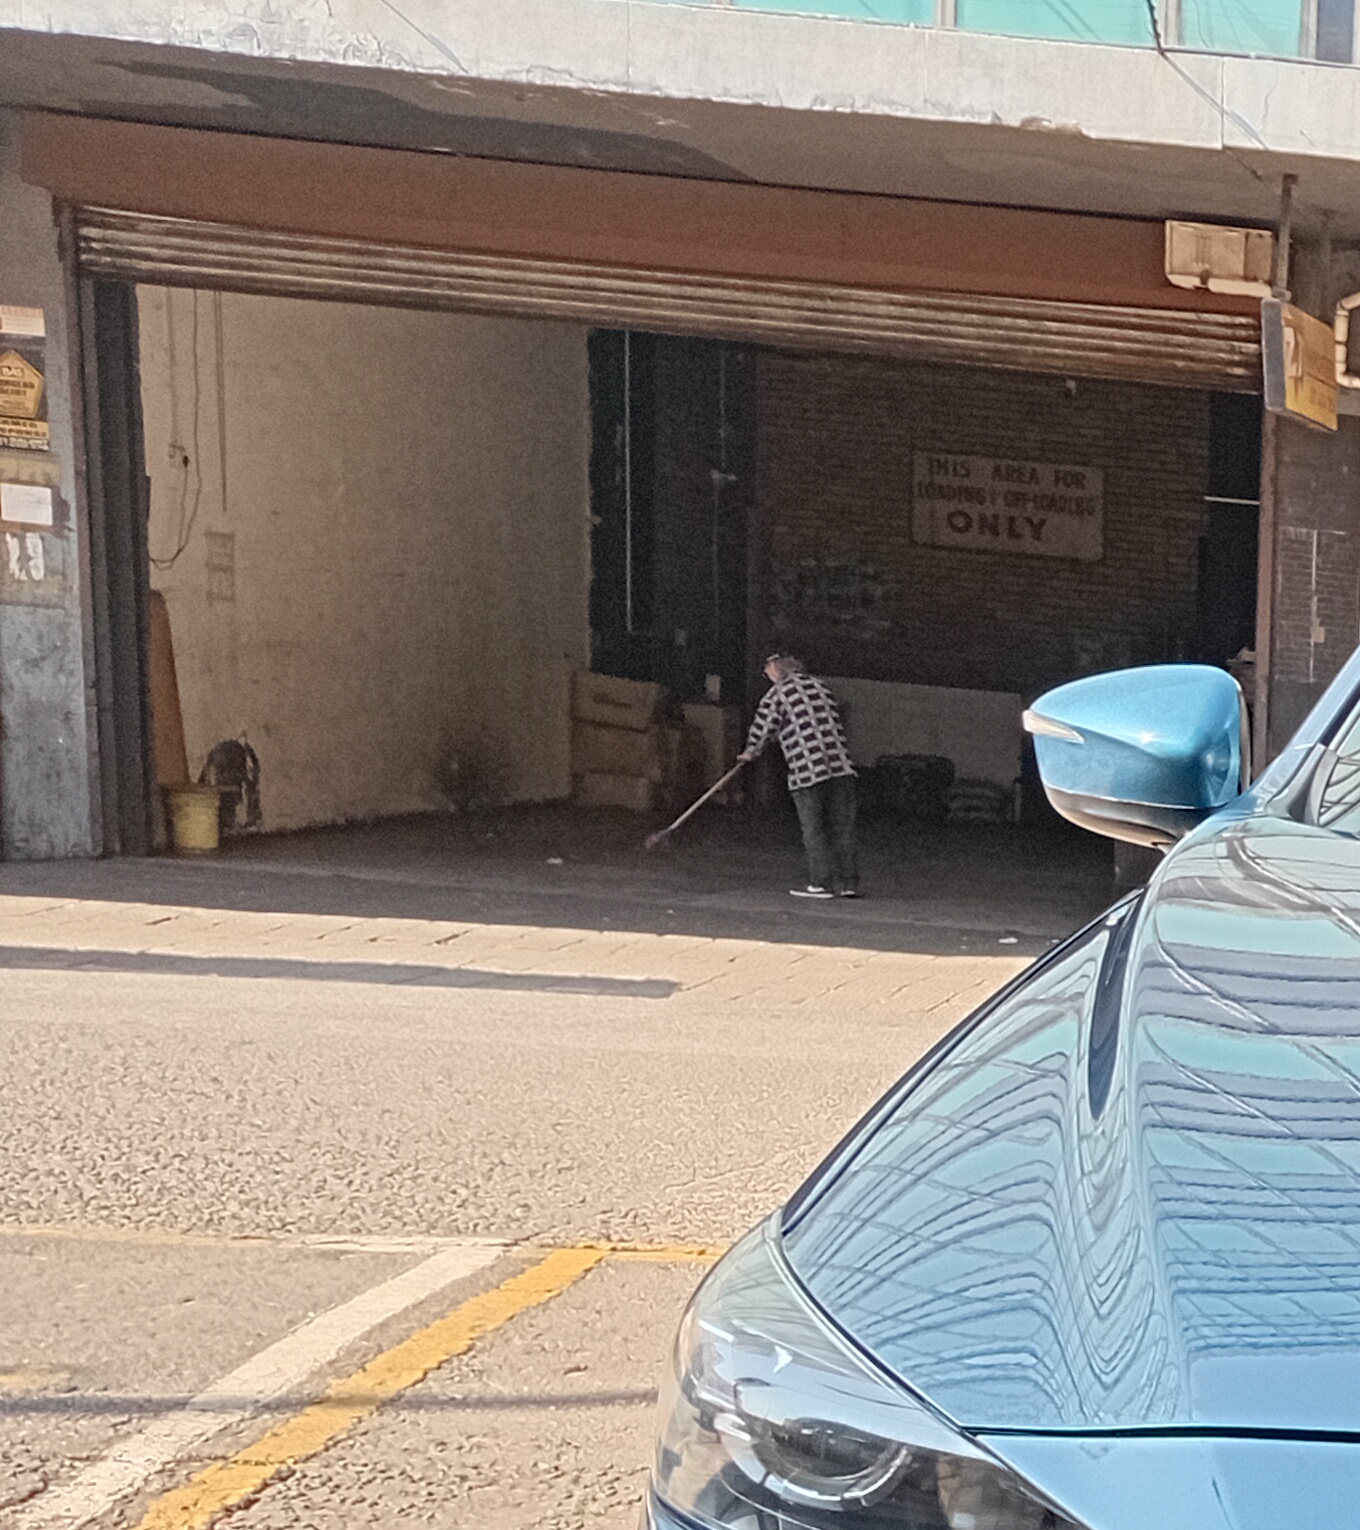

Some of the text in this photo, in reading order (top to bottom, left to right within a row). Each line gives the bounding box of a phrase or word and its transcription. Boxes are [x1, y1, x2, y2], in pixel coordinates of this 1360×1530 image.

[992, 464, 1040, 485] AREA
[1053, 469, 1087, 489] FOR
[946, 509, 1047, 541] ONLY
